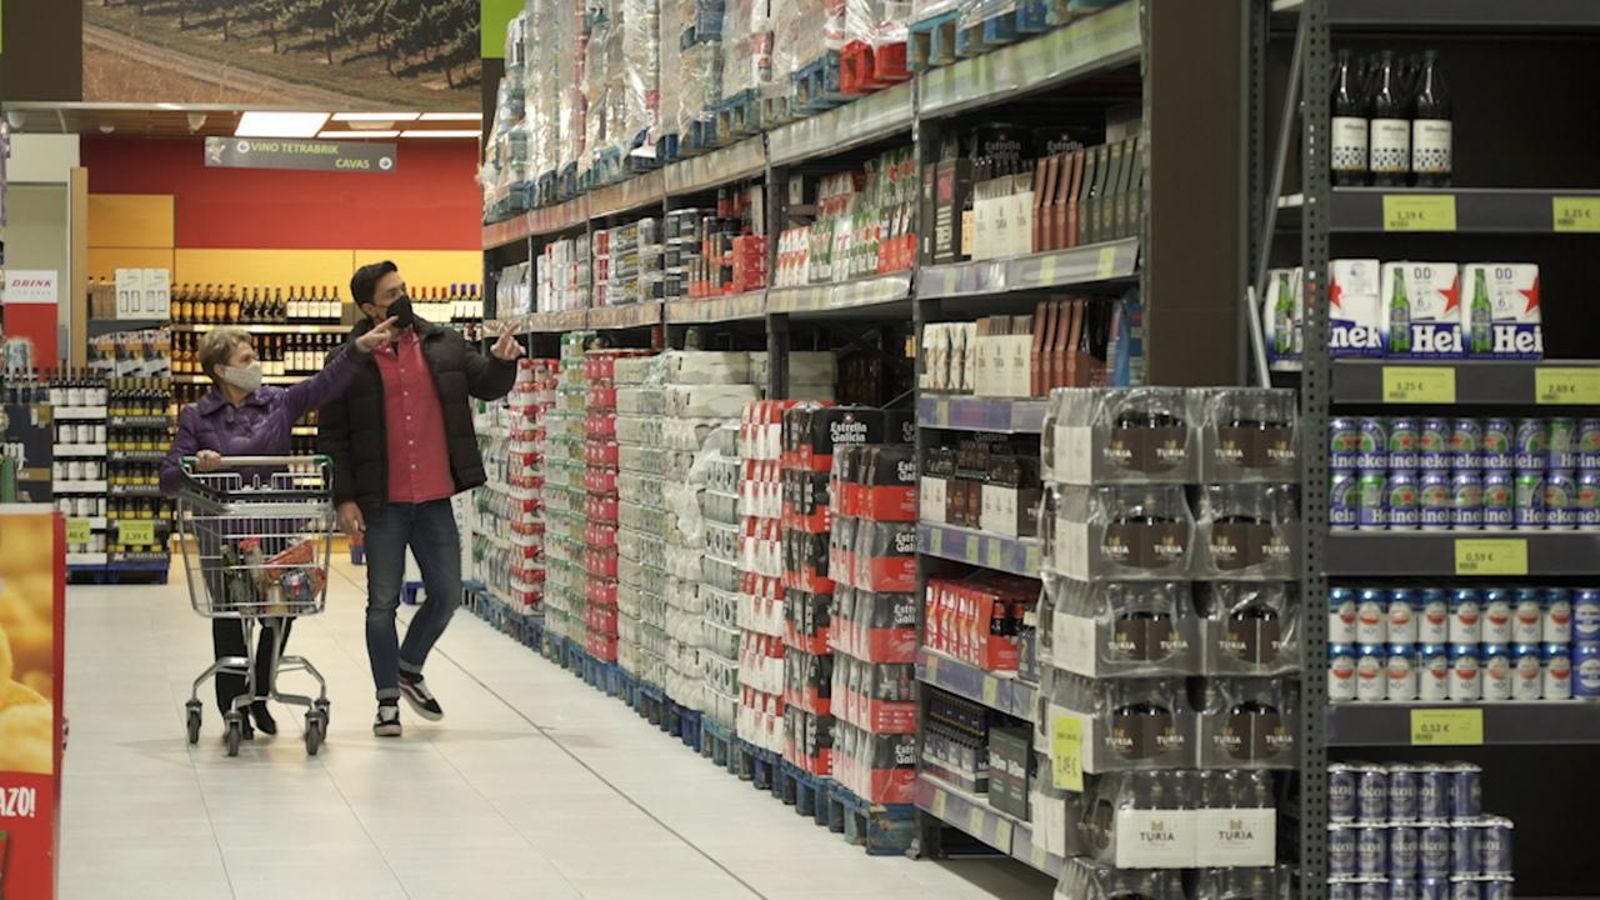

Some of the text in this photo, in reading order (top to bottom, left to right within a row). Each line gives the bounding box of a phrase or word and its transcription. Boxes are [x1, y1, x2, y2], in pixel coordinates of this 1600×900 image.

[251, 143, 339, 154] VINO TETRABRIK
[335, 158, 370, 169] CAVAS
[11, 280, 52, 288] DRINK
[1493, 325, 1544, 353] Hei
[830, 421, 867, 433] Estrella
[830, 432, 866, 443] Galicia
[1156, 448, 1185, 458] TURIA
[1154, 545, 1183, 554] TURIA
[1160, 640, 1189, 650] TURIA
[1105, 737, 1134, 747] TURIA
[1157, 735, 1185, 745] TURIA
[1140, 831, 1176, 841] TURIA
[1219, 831, 1254, 841] TURIA
